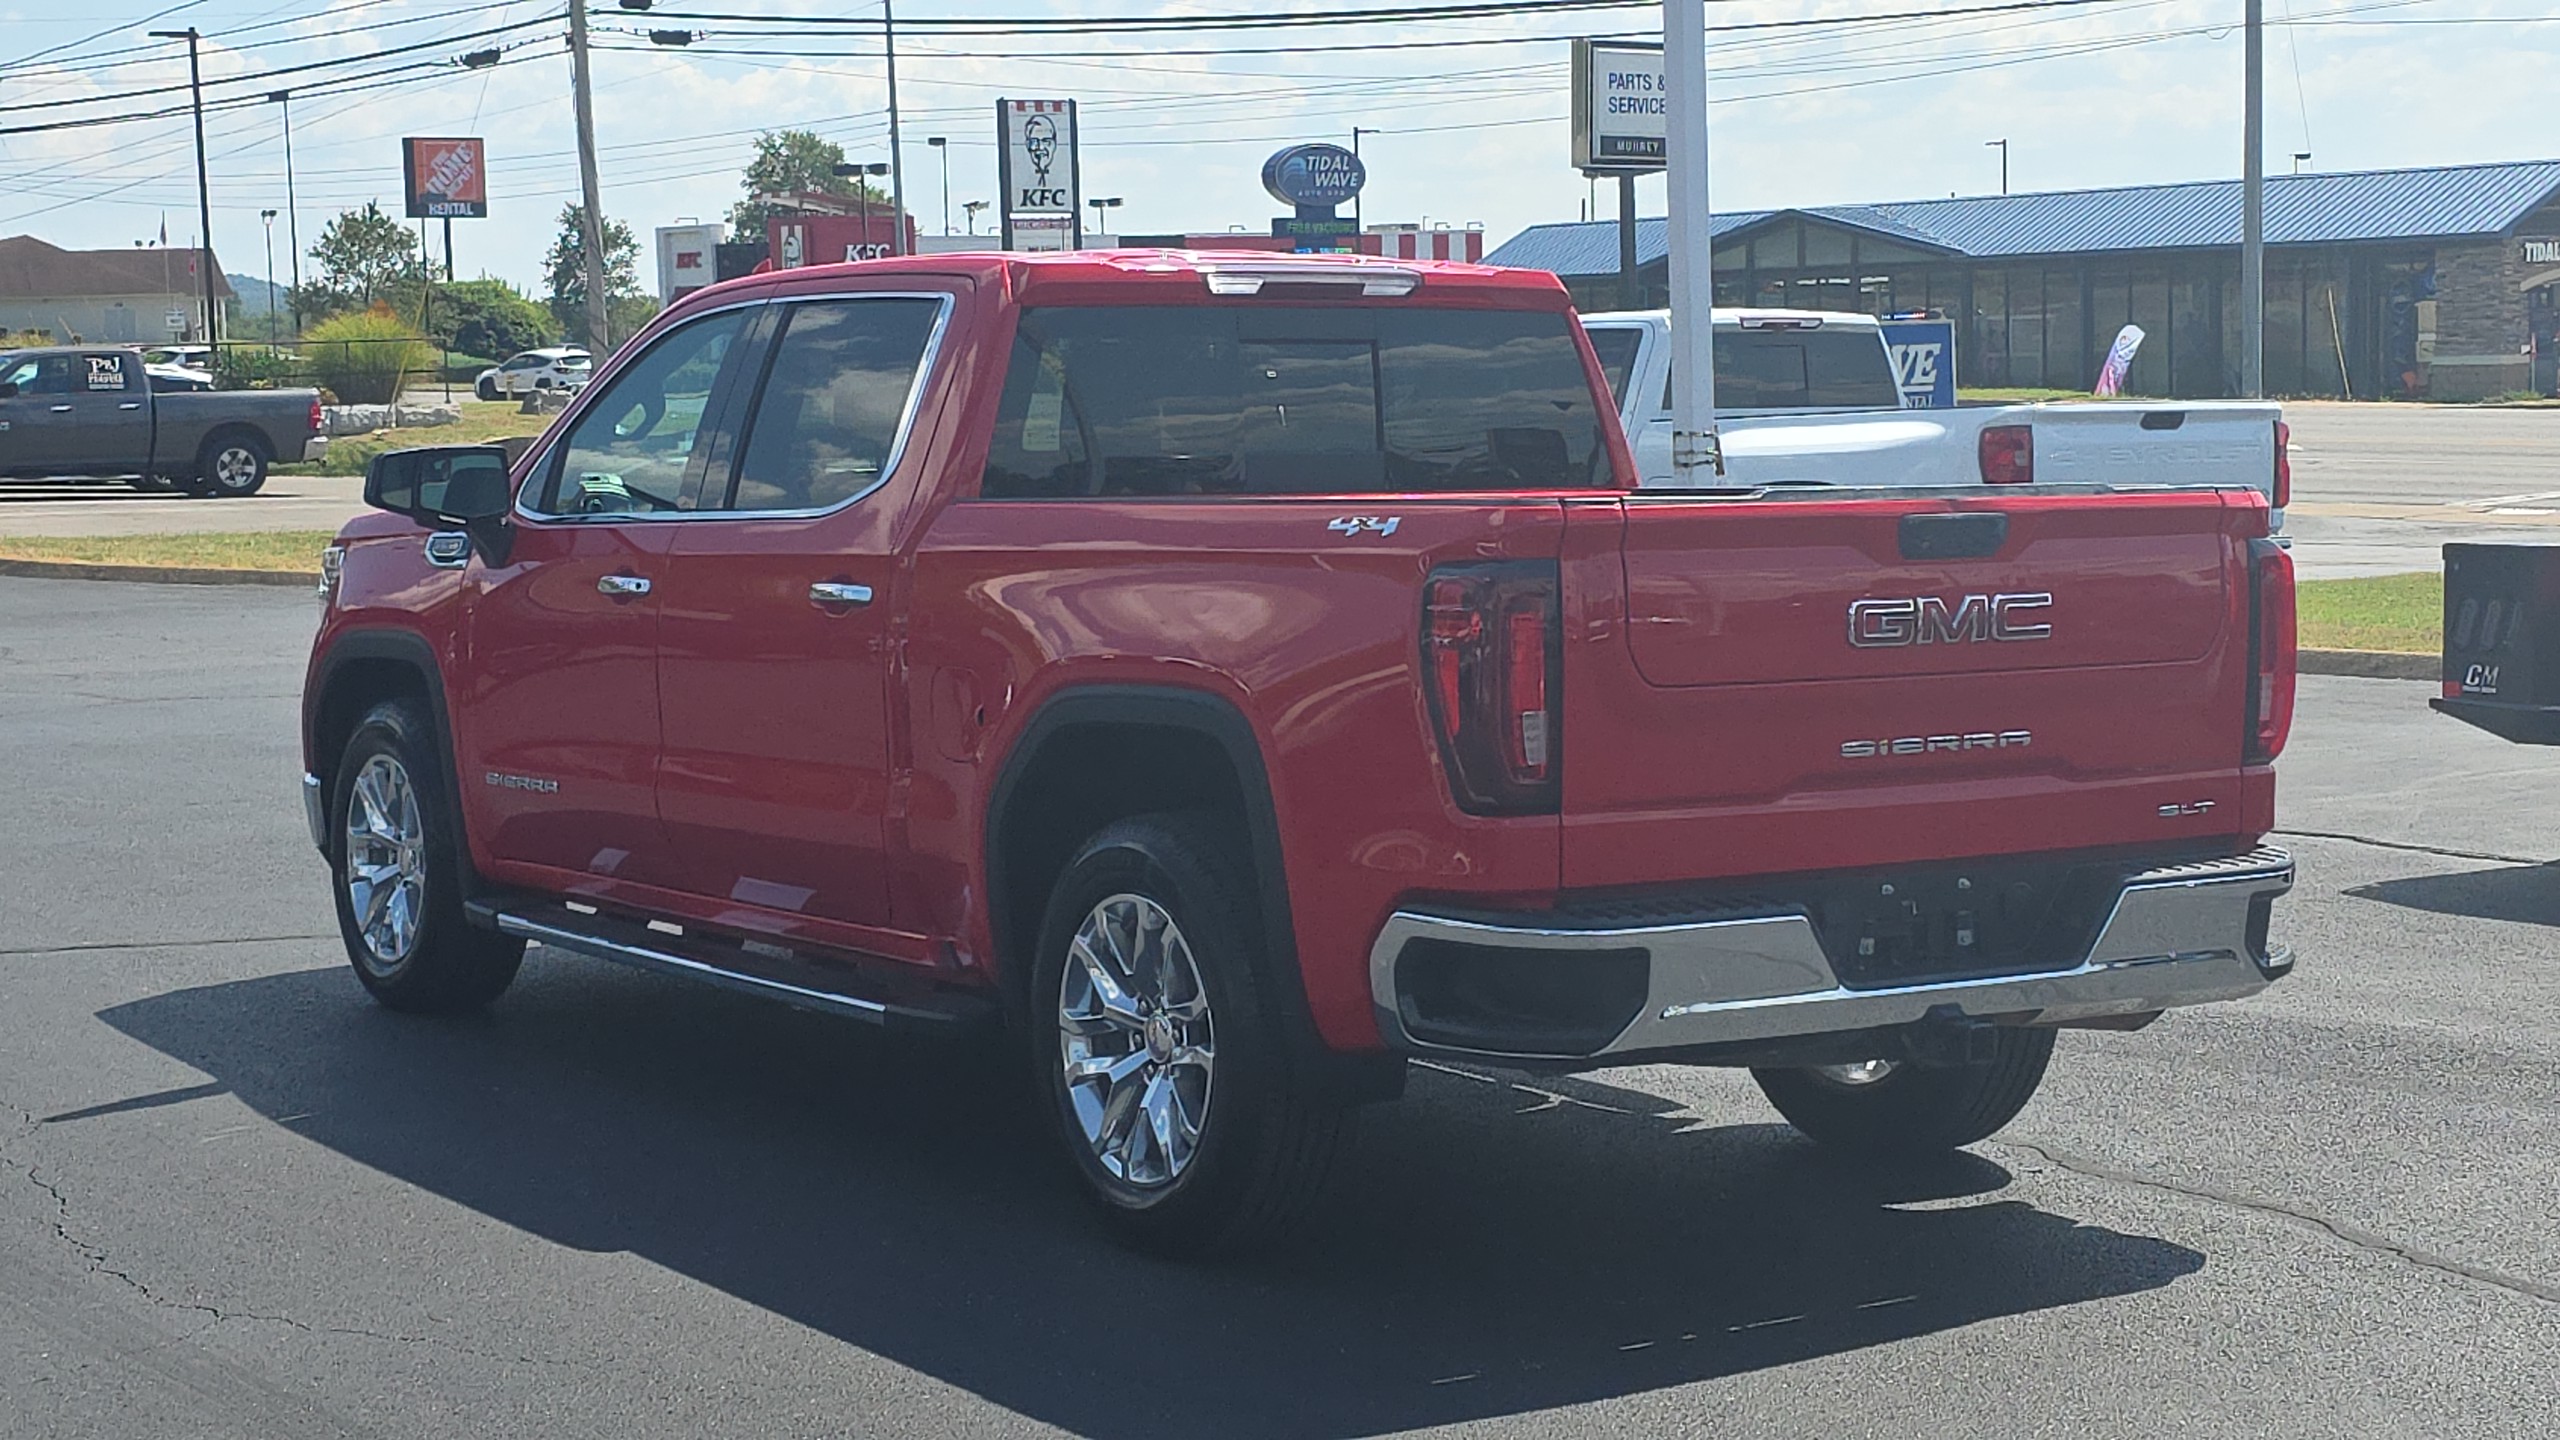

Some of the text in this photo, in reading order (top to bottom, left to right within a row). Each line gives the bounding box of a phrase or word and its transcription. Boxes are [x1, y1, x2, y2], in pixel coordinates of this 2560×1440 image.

[1608, 72, 1665, 92] PARTS &
[1608, 96, 1666, 114] SERVICE
[425, 142, 474, 195] HOME
[1307, 155, 1349, 172] TIDAL
[1314, 172, 1359, 187] WAVE
[1020, 188, 1066, 207] KFC
[428, 203, 474, 215] RENTAL
[845, 244, 890, 262] KFC
[2524, 242, 2560, 262] TIDAL
[1848, 592, 2052, 647] GMC
[2465, 664, 2499, 686] CM
[1841, 729, 2031, 758] SIERRA
[485, 772, 559, 793] SIERRA
[2158, 801, 2216, 816] SLT
